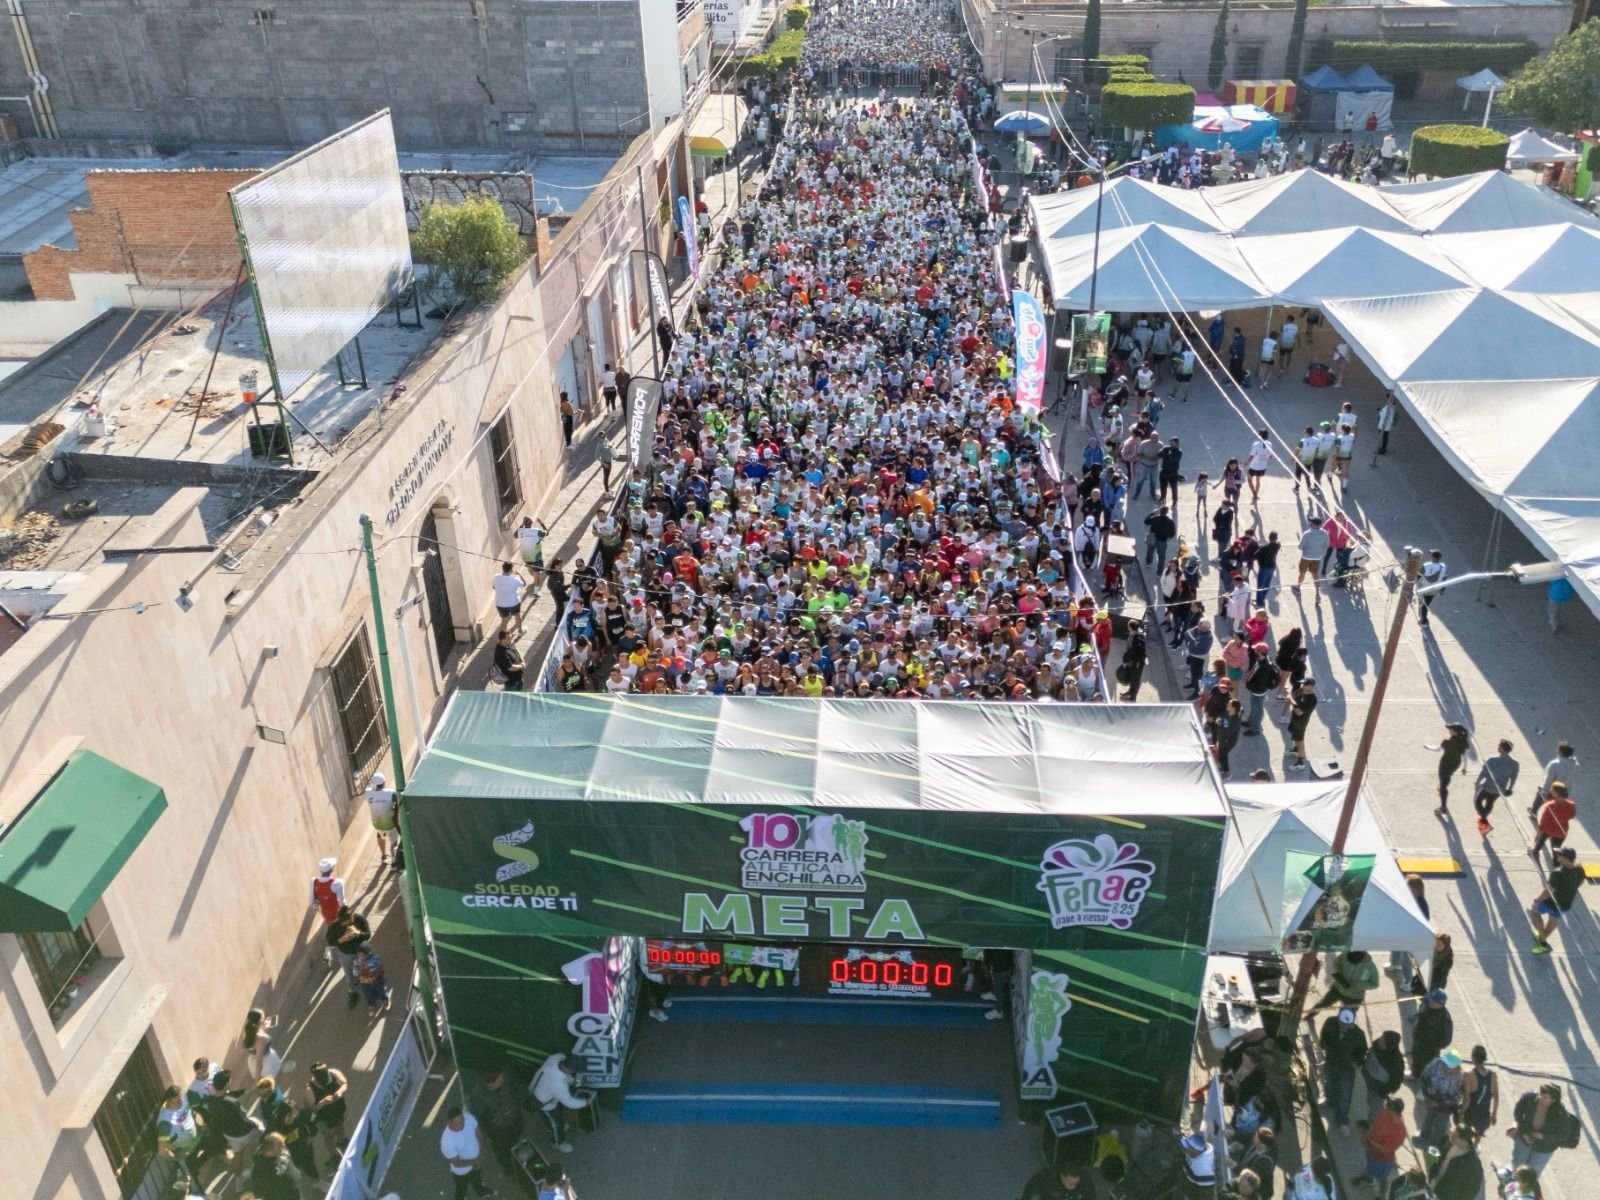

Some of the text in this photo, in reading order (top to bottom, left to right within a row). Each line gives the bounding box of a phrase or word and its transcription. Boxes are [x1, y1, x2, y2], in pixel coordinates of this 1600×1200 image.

[743, 849, 844, 863] CARRERA
[745, 861, 831, 873] ATLETICA
[745, 871, 864, 885] ENCHILADA
[474, 883, 560, 896] SOLEDAD
[461, 895, 528, 908] CERCA
[530, 897, 557, 909] DE
[682, 893, 926, 940] META
[832, 960, 952, 986] 0:00:00
